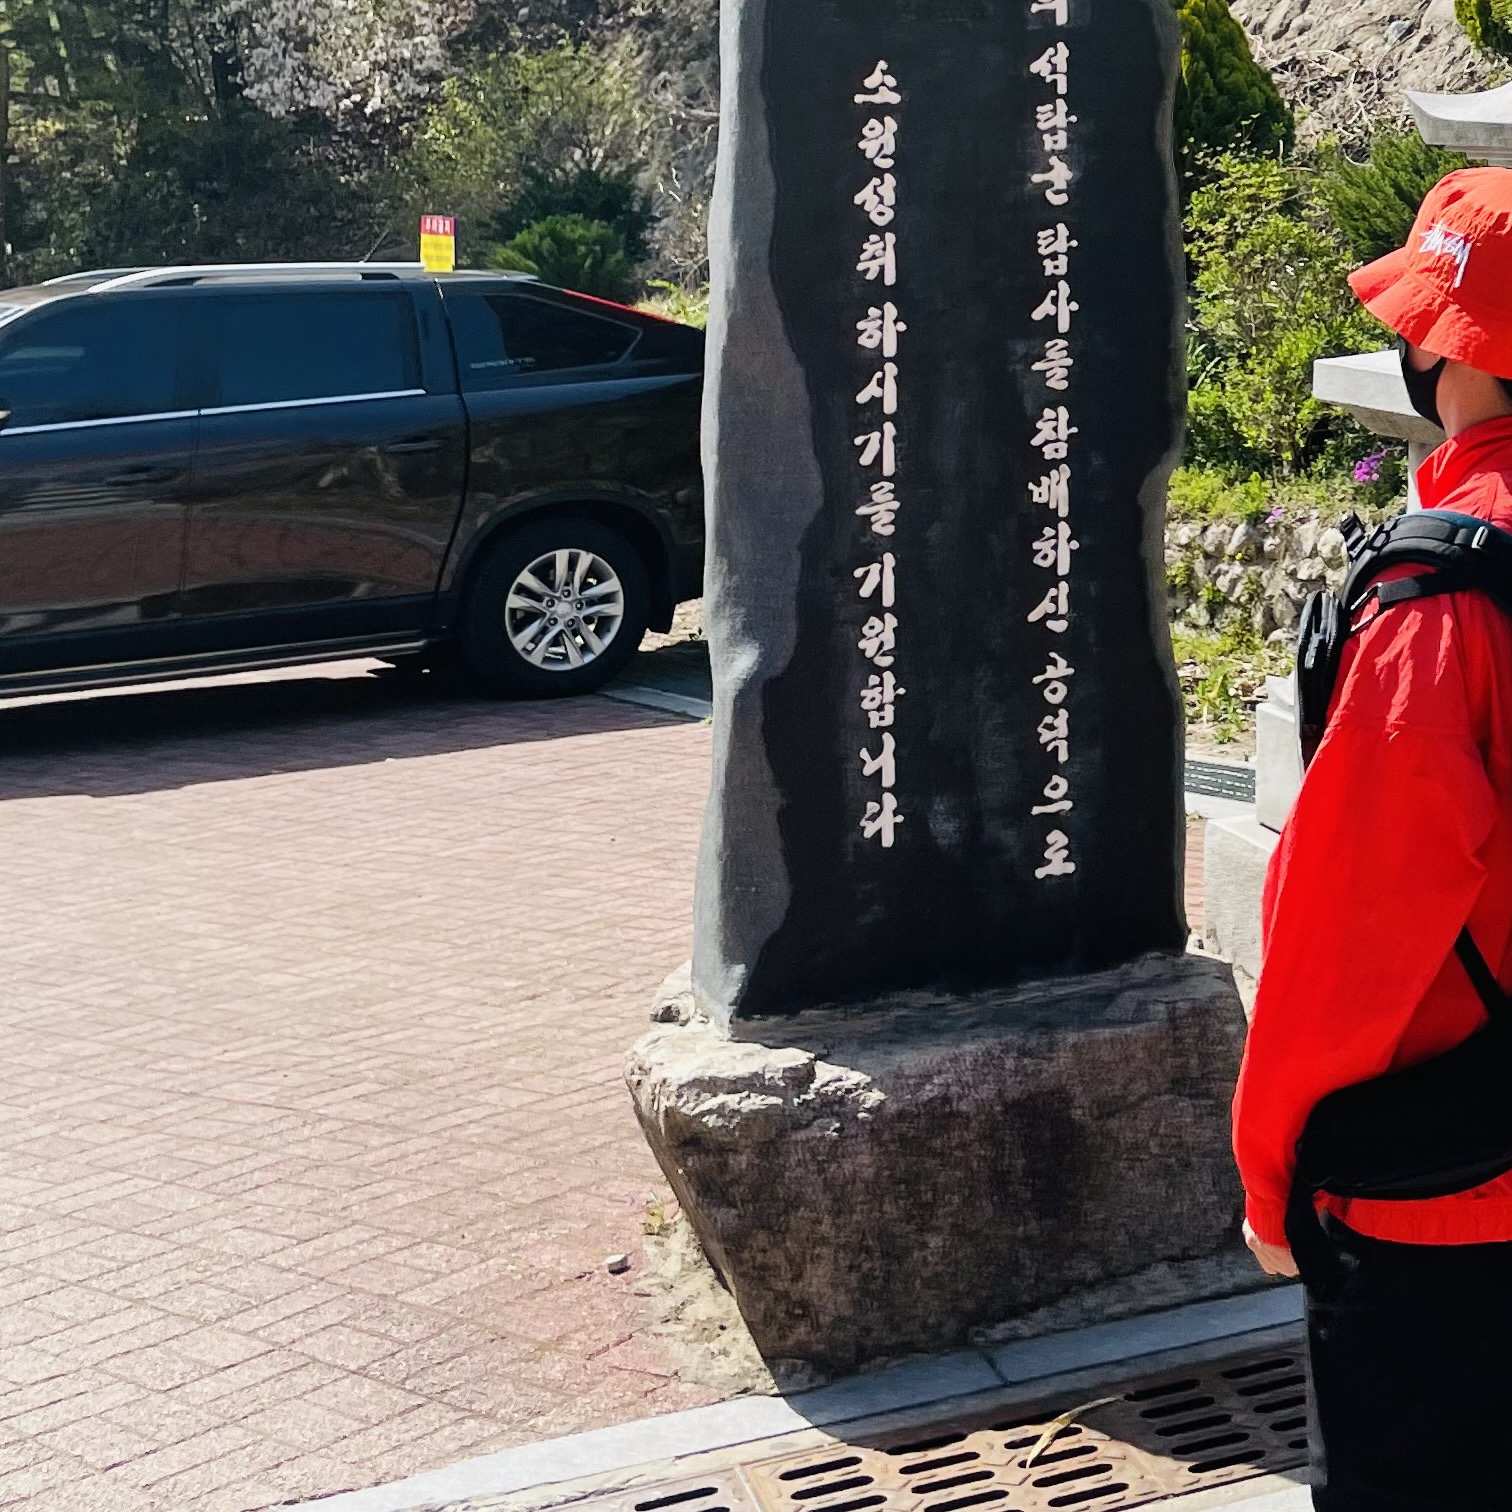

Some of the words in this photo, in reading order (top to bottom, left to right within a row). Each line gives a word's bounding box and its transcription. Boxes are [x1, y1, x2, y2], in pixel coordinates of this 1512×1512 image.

[853, 58, 902, 286] 소원성취
[1028, 41, 1078, 206] 석탑군
[853, 301, 907, 536] 하시기를
[1030, 222, 1080, 390] 탑사를
[1027, 404, 1080, 634] 참배하신
[853, 552, 907, 849] 기원합니다
[1031, 650, 1076, 879] 공덕으로
